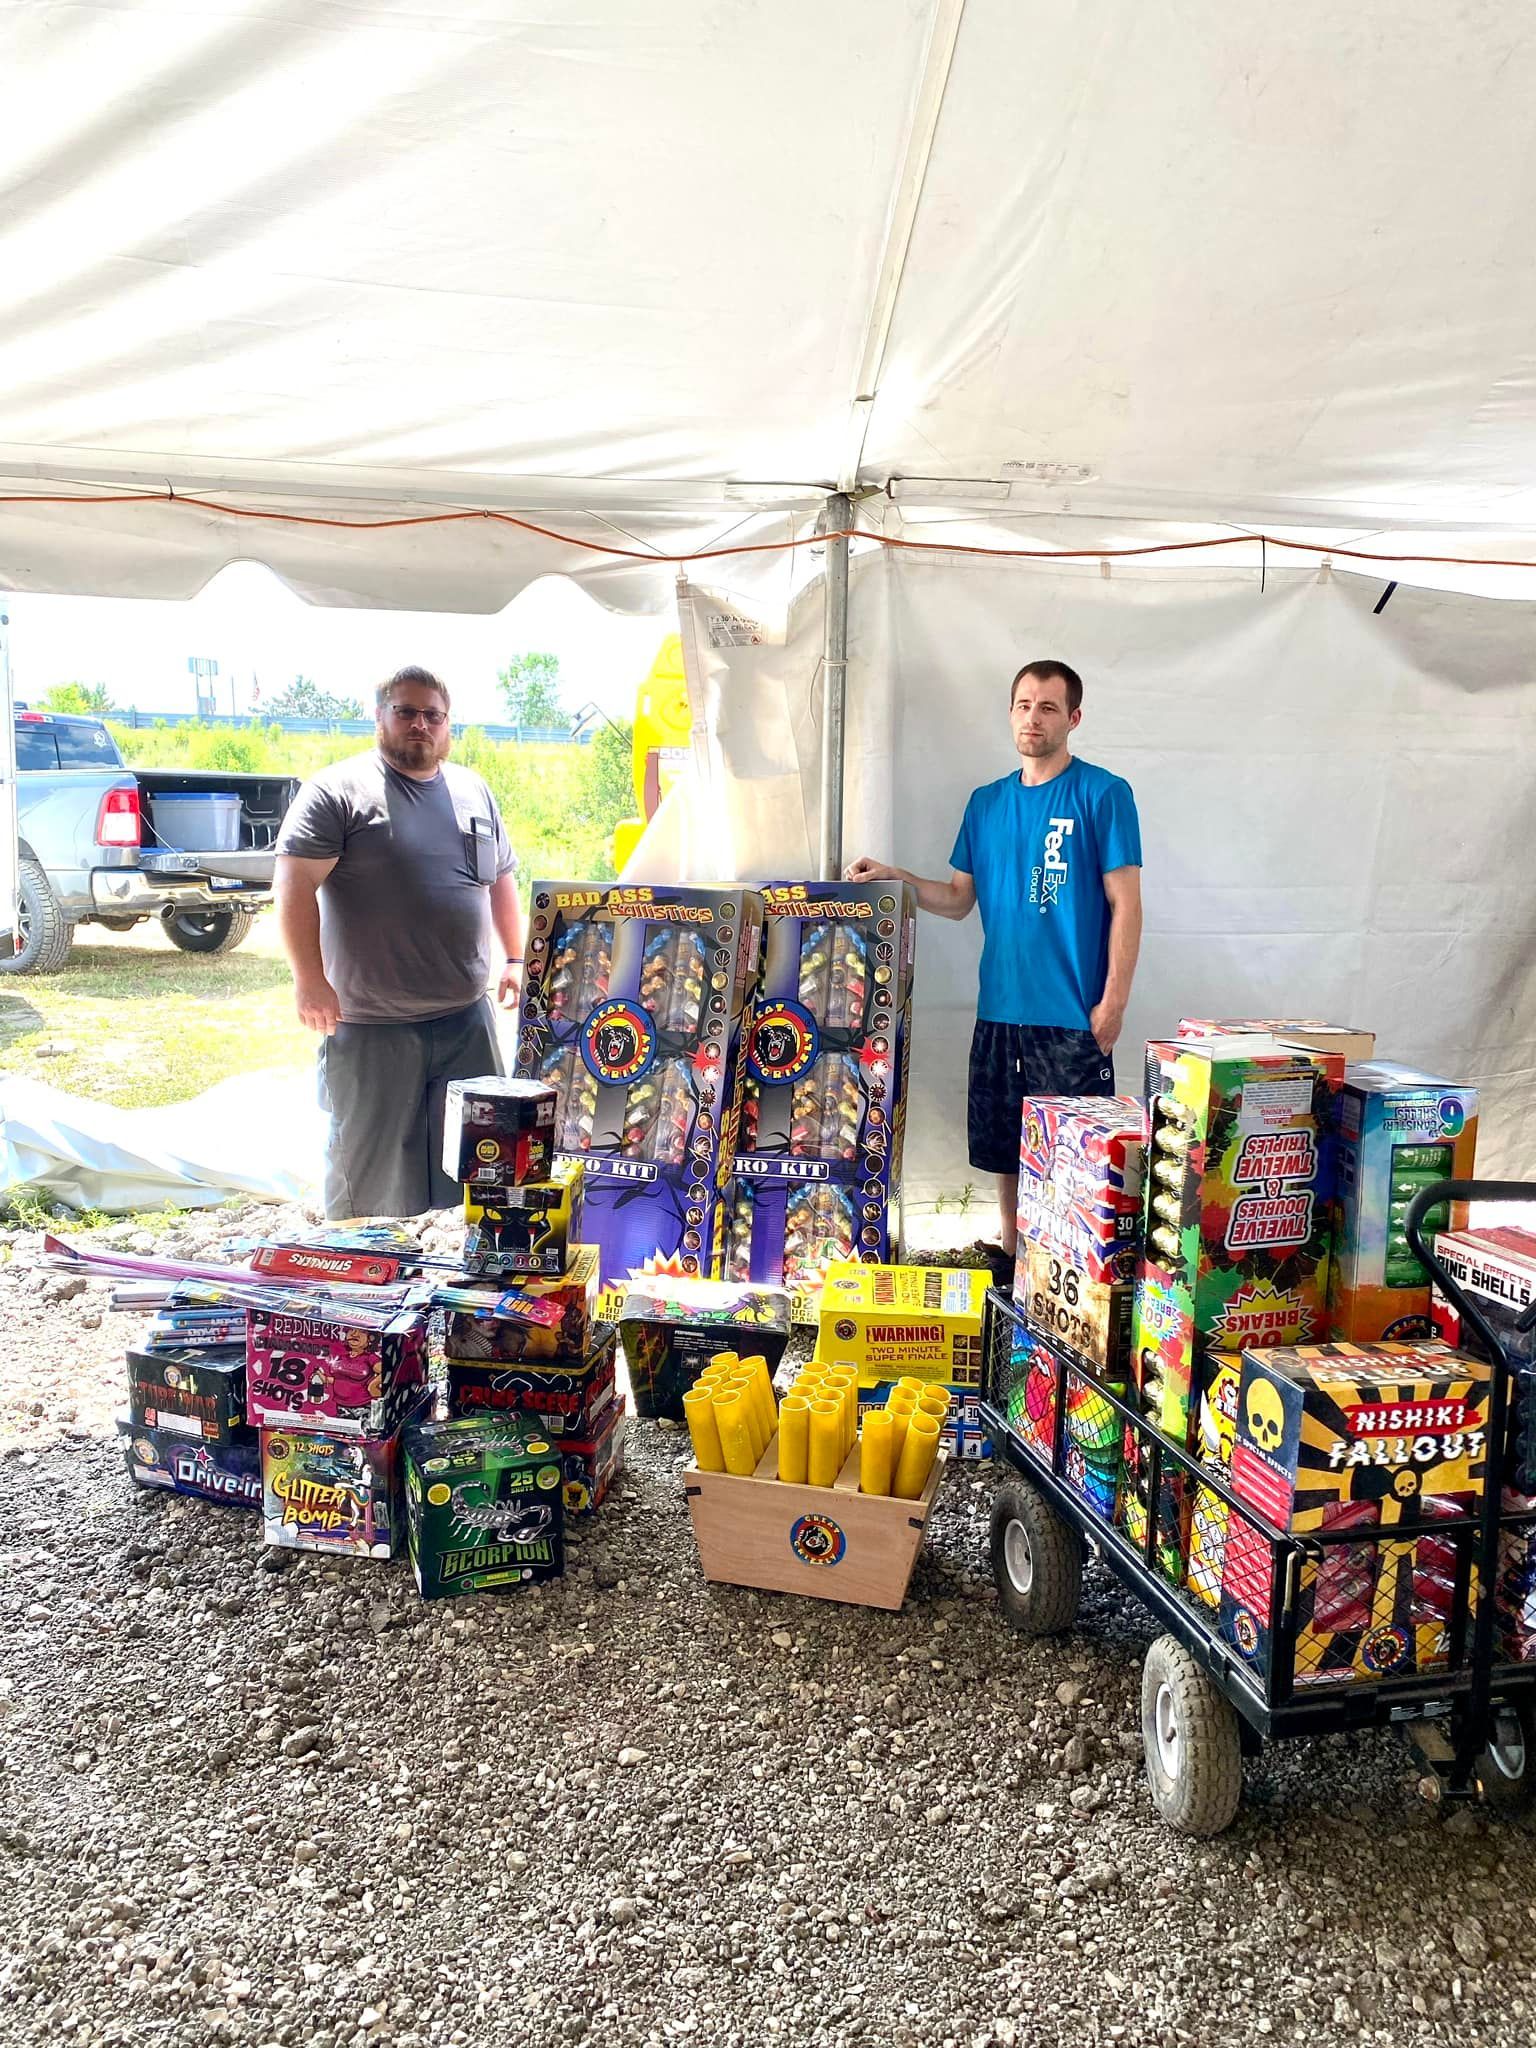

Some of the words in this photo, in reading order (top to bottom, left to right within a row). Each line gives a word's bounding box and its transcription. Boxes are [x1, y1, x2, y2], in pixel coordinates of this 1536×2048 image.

[1041, 818, 1074, 905] FedEx
[760, 885, 807, 904] ASS
[1029, 866, 1042, 903] Ground
[556, 891, 600, 907] BAD
[607, 887, 653, 904] ASS
[586, 1004, 626, 1038] GREAT
[600, 1033, 650, 1079] GRIZZLY
[761, 1032, 812, 1078] GRIZZLY
[1384, 1119, 1437, 1132] CANISTER
[1397, 1108, 1437, 1120] SHELLS
[1440, 1098, 1464, 1137] 6
[1246, 1134, 1308, 1154] TRIPLES
[612, 1161, 653, 1178] KIT
[732, 1159, 768, 1173] RO
[781, 1162, 825, 1177] KIT
[1236, 1152, 1313, 1179] TWELVE
[1267, 1179, 1280, 1197] &
[1239, 1196, 1308, 1218] DOUBLES
[1117, 1216, 1134, 1231] 30
[1231, 1216, 1307, 1243] TWELVE
[289, 1253, 353, 1272] SPARKLERS
[1437, 1244, 1479, 1268] SPECIAL
[1483, 1263, 1532, 1289] EFFECTS
[1050, 1259, 1080, 1306] 36
[1471, 1268, 1531, 1306] SHELLS
[605, 1294, 624, 1308] 10
[792, 1296, 814, 1309] 02
[274, 1317, 339, 1340] REDNECK
[1033, 1292, 1091, 1349] SHOTS
[1226, 1309, 1300, 1332] BREAKS
[871, 1326, 939, 1343] WARNING
[907, 1353, 949, 1361] FINALE
[1316, 1354, 1427, 1369] NISHIKI
[269, 1357, 306, 1386] 18
[1315, 1362, 1470, 1383] FALLOUT
[252, 1379, 305, 1411] SHOTS
[967, 1406, 980, 1418] 30
[1356, 1405, 1466, 1433] NISHIKI
[295, 1442, 305, 1453] 12
[308, 1442, 335, 1456] SHOTS
[1242, 1439, 1266, 1461] SPECIAL
[1267, 1455, 1292, 1480] EFFECTS
[1329, 1432, 1485, 1468] FALLOUT
[452, 1456, 477, 1467] 25
[272, 1471, 347, 1507] GLITTER
[510, 1470, 534, 1488] 25
[282, 1505, 342, 1531] BOMB
[443, 1537, 551, 1578] SCORPION
